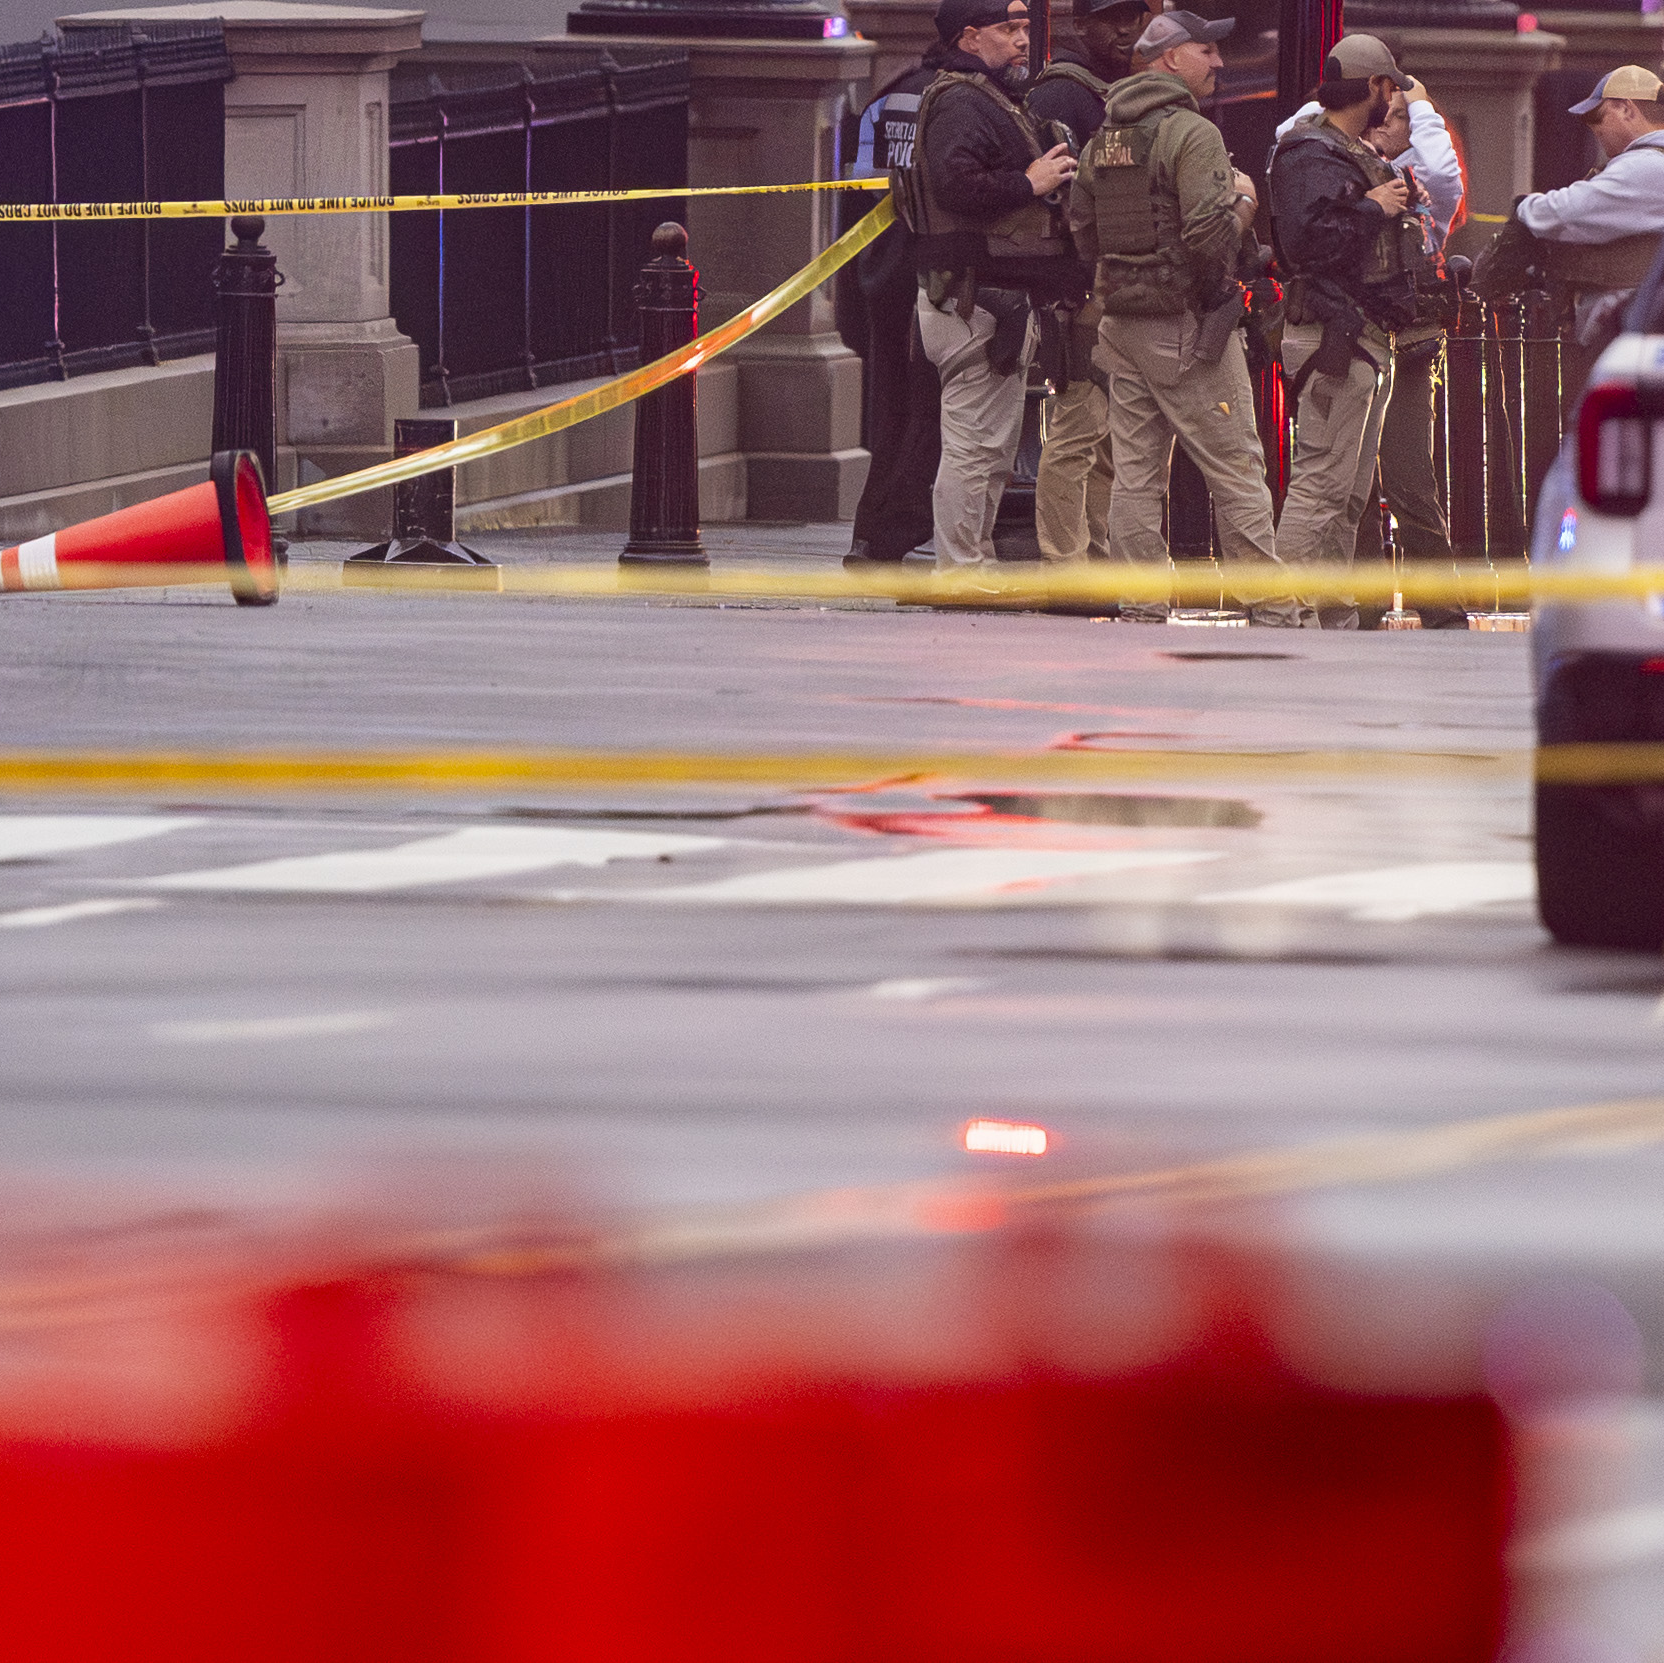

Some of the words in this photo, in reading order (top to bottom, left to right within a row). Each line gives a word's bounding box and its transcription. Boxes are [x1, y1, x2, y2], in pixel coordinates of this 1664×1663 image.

[36, 204, 61, 218] NOT
[87, 203, 113, 217] LINE
[118, 202, 162, 216] POLICE
